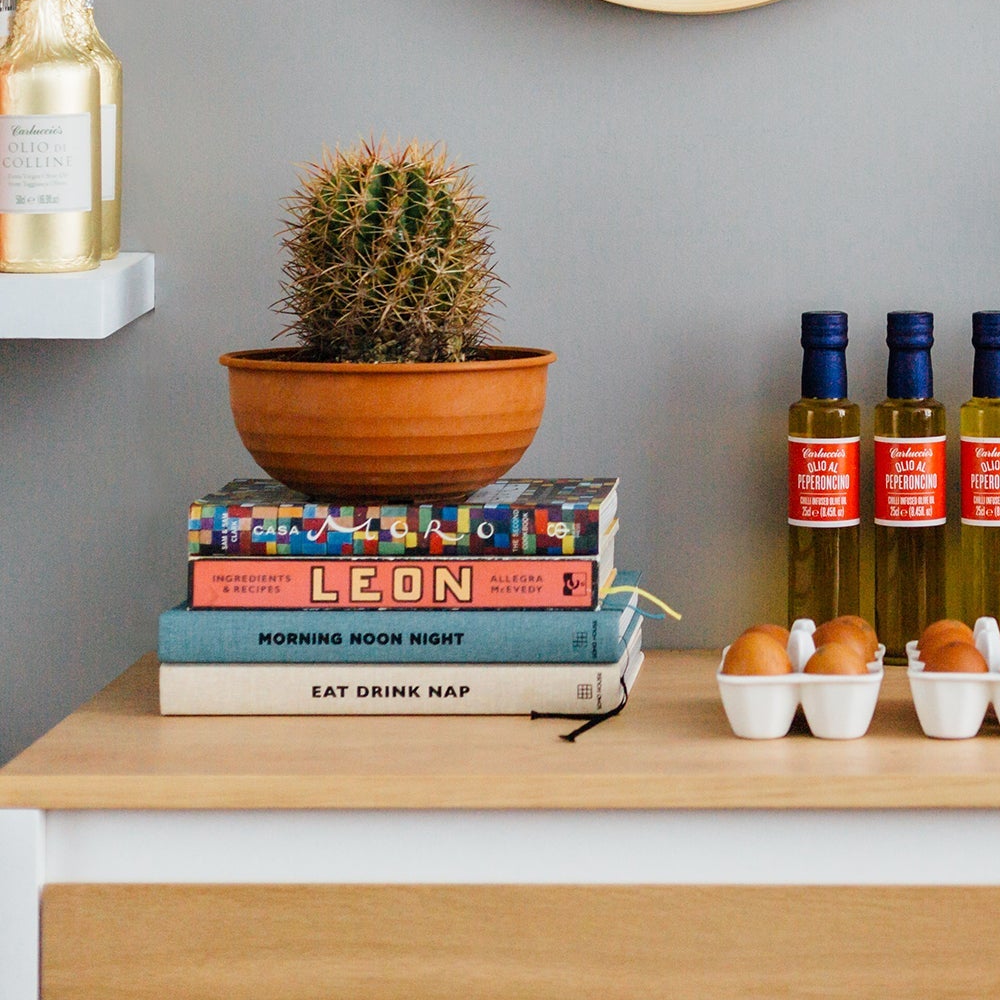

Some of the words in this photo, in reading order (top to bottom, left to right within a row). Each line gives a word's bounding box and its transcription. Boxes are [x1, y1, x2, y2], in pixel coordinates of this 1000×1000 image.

[11, 125, 63, 136] Carluccio's
[8, 142, 49, 153] OLIO
[3, 156, 72, 168] COLLINE
[802, 448, 846, 459] Carluccio's
[889, 447, 933, 458] Carluccio's
[807, 460, 827, 473] OLIO
[828, 461, 839, 473] AL
[895, 460, 915, 473] OLIO
[916, 461, 927, 473] AL
[980, 460, 1000, 473] OLIO
[797, 474, 850, 491] PEPERONCINO
[885, 473, 938, 490] PEPERONCINO
[512, 509, 520, 538] SECOND
[253, 525, 300, 536] CASA
[212, 574, 292, 583] INGREDIENTS
[310, 565, 473, 603] LEON
[490, 574, 544, 583] ALLEGRA
[222, 586, 230, 594] &
[234, 585, 281, 594] RECIPES
[258, 632, 343, 646] MORNING
[350, 632, 402, 646] NOON
[409, 632, 464, 646] NIGHT
[312, 685, 348, 698] EAT
[356, 685, 420, 698] DRINK
[428, 685, 471, 698] NAP
